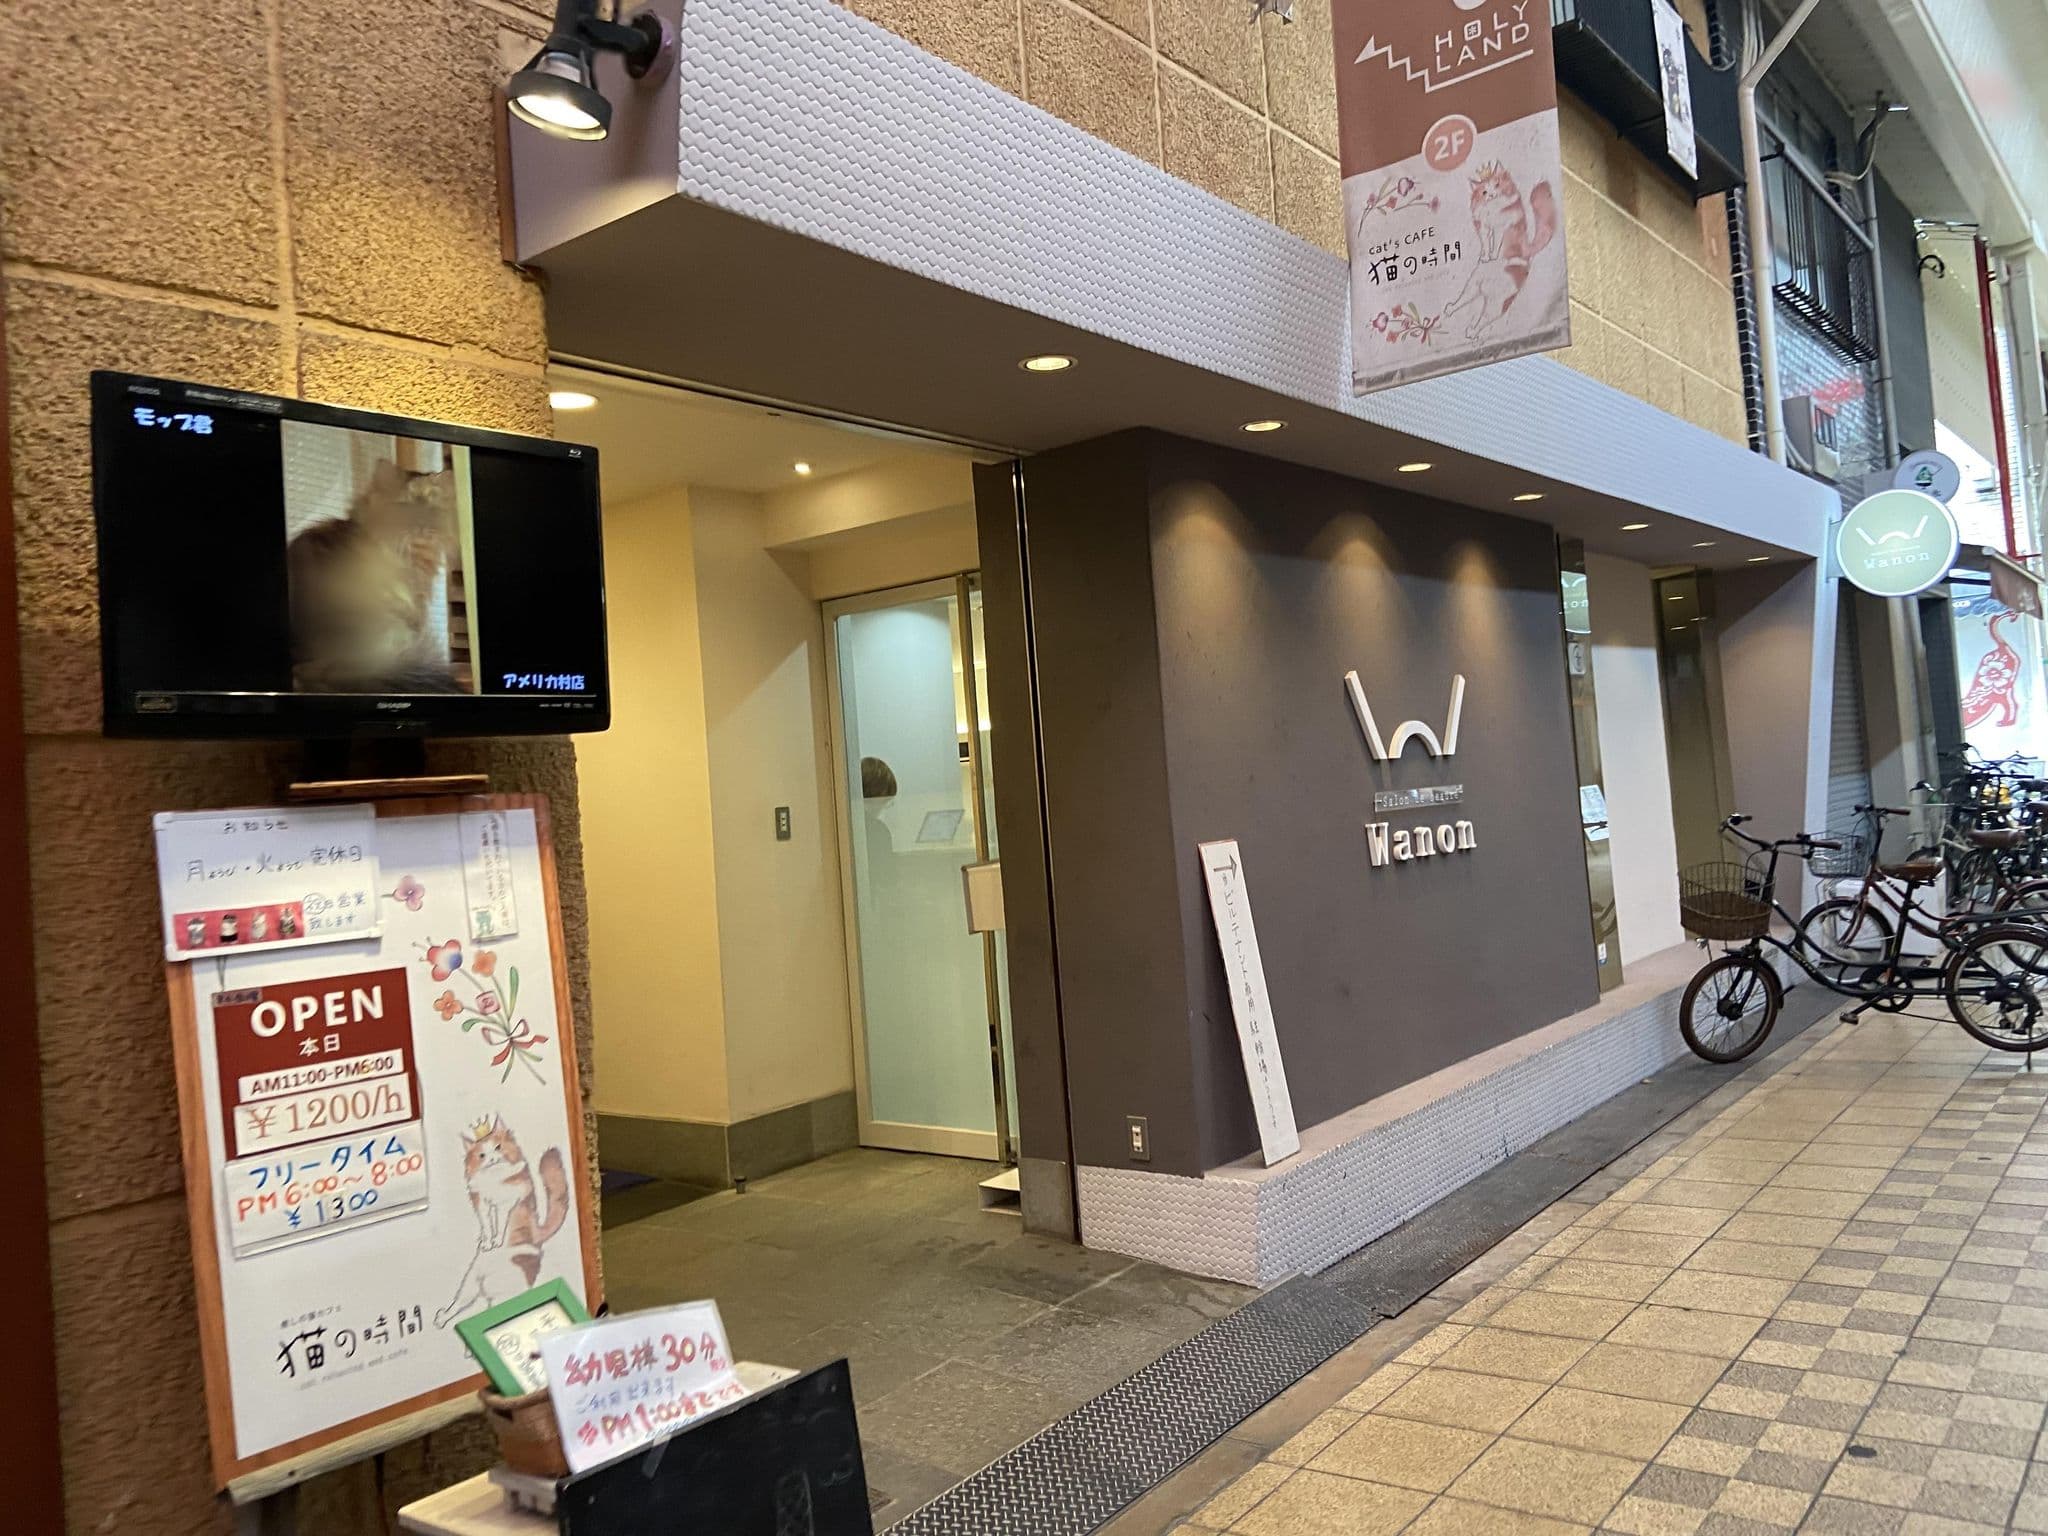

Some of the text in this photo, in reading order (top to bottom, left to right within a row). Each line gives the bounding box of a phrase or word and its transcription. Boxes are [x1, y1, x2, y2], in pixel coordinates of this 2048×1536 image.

[1435, 0, 1528, 53] HOLY
[1436, 23, 1529, 73] LAND
[1434, 129, 1465, 161] 2F
[1368, 226, 1436, 255] cat's CAFE
[1368, 241, 1461, 285] 猫の時間
[1864, 551, 1930, 571] Wanon
[502, 672, 585, 691] アメリカ村店
[309, 845, 363, 866] 定休日
[1364, 820, 1478, 867] Wanon
[250, 985, 384, 1038] OPEN
[298, 1033, 341, 1057] 本日
[250, 1055, 394, 1096] AM11:00-PM6:00
[249, 1135, 406, 1189] フリータイム
[275, 1304, 423, 1378] 猫の時間
